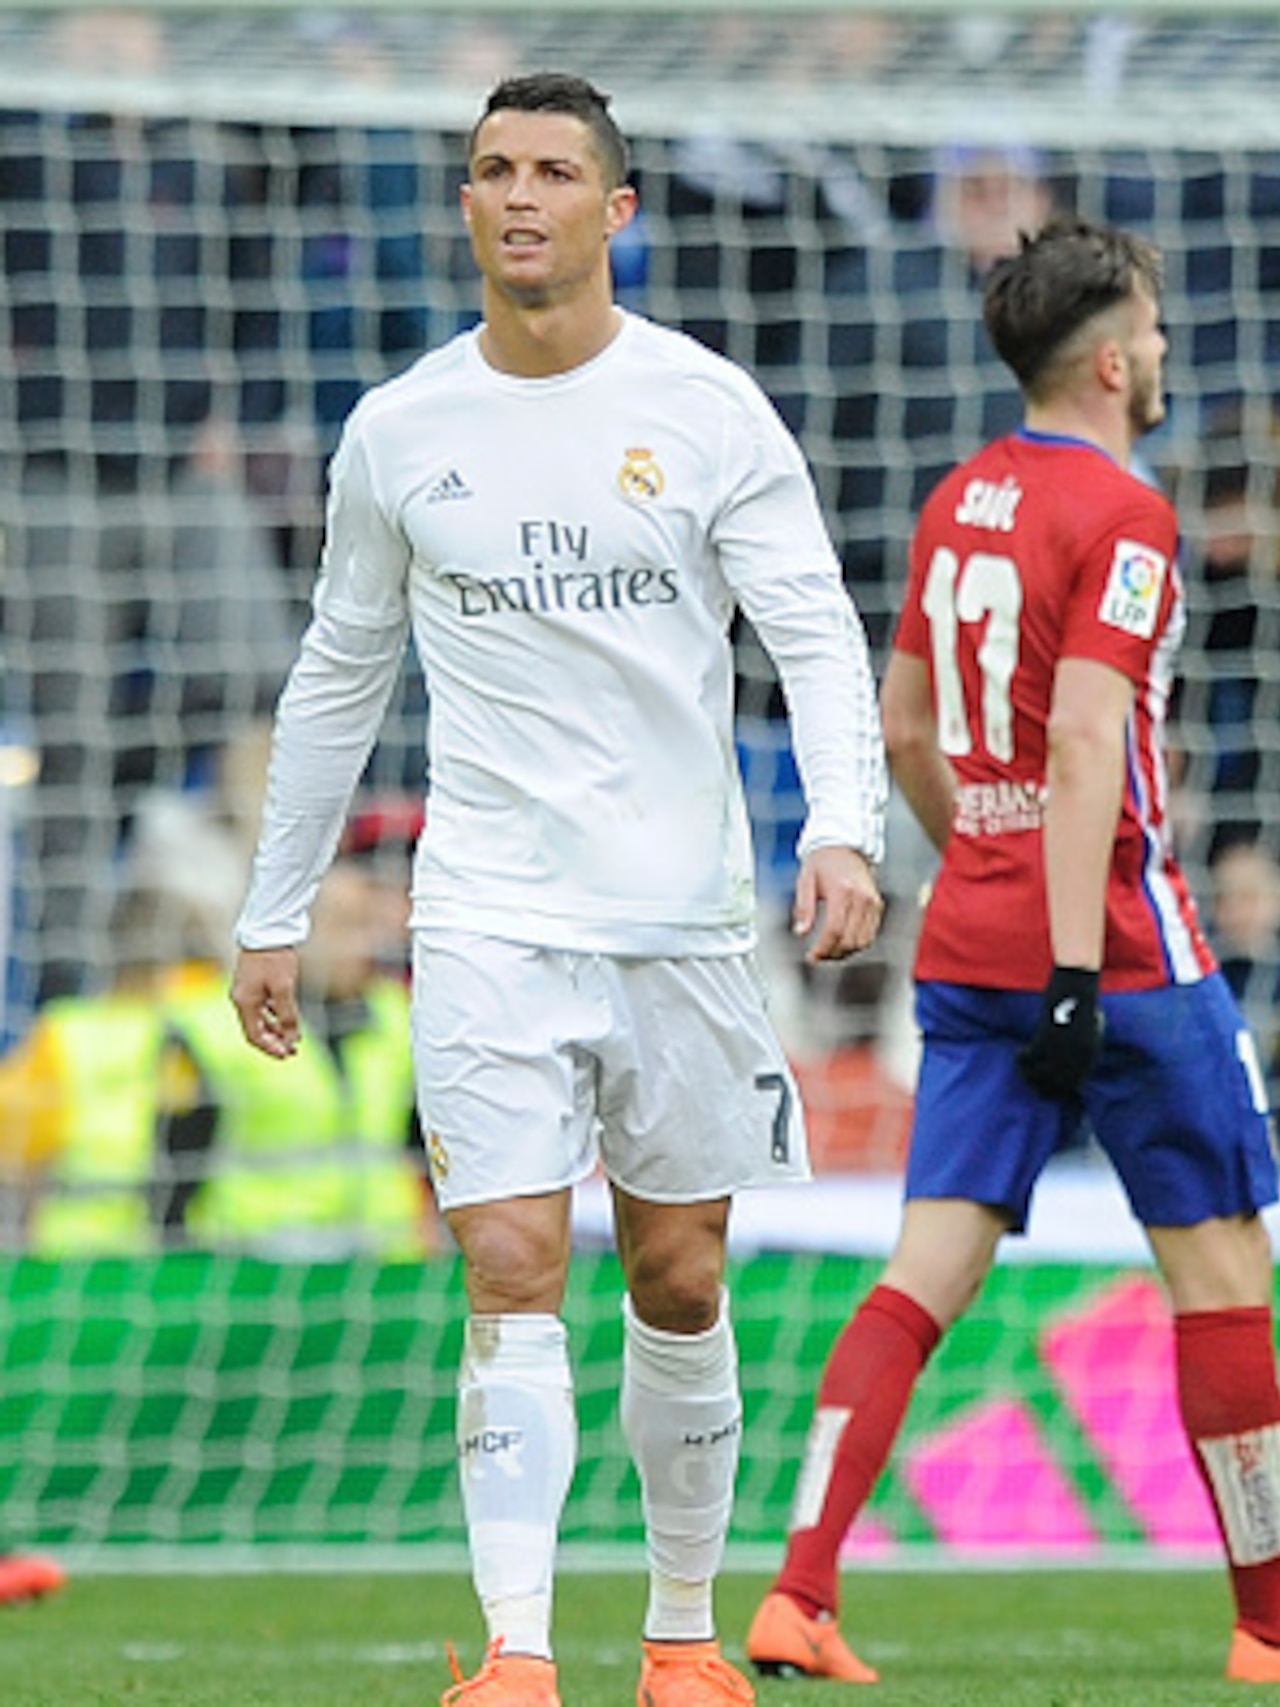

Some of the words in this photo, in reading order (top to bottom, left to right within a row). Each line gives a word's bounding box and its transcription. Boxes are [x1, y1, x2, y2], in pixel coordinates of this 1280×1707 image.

[520, 521, 588, 561] Fly
[442, 562, 680, 617] Emirates
[921, 546, 1023, 764] 17
[754, 1074, 793, 1164] 7
